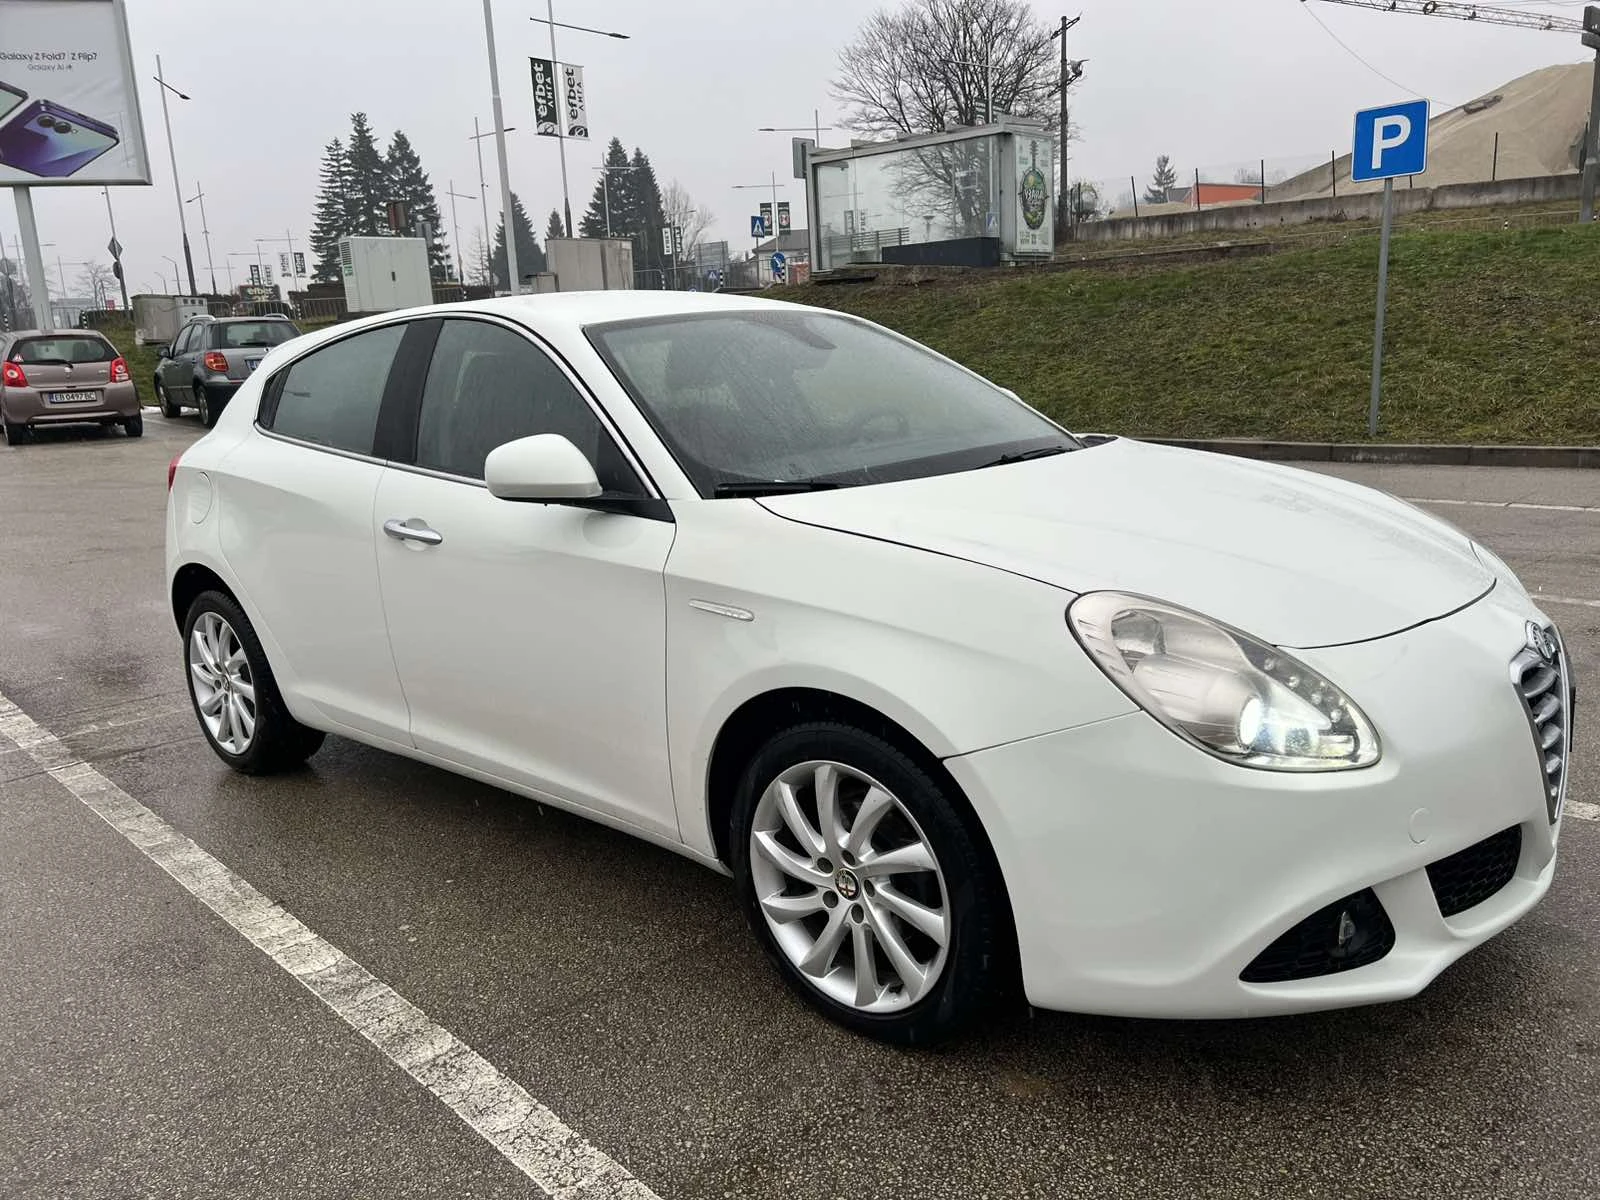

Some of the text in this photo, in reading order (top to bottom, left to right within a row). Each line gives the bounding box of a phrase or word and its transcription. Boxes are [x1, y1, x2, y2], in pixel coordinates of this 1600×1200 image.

[0, 52, 97, 62] Galaxy Z Fold7 Z Flip7
[533, 63, 548, 118] efbet
[565, 67, 579, 120] efbet
[1372, 115, 1411, 169] P
